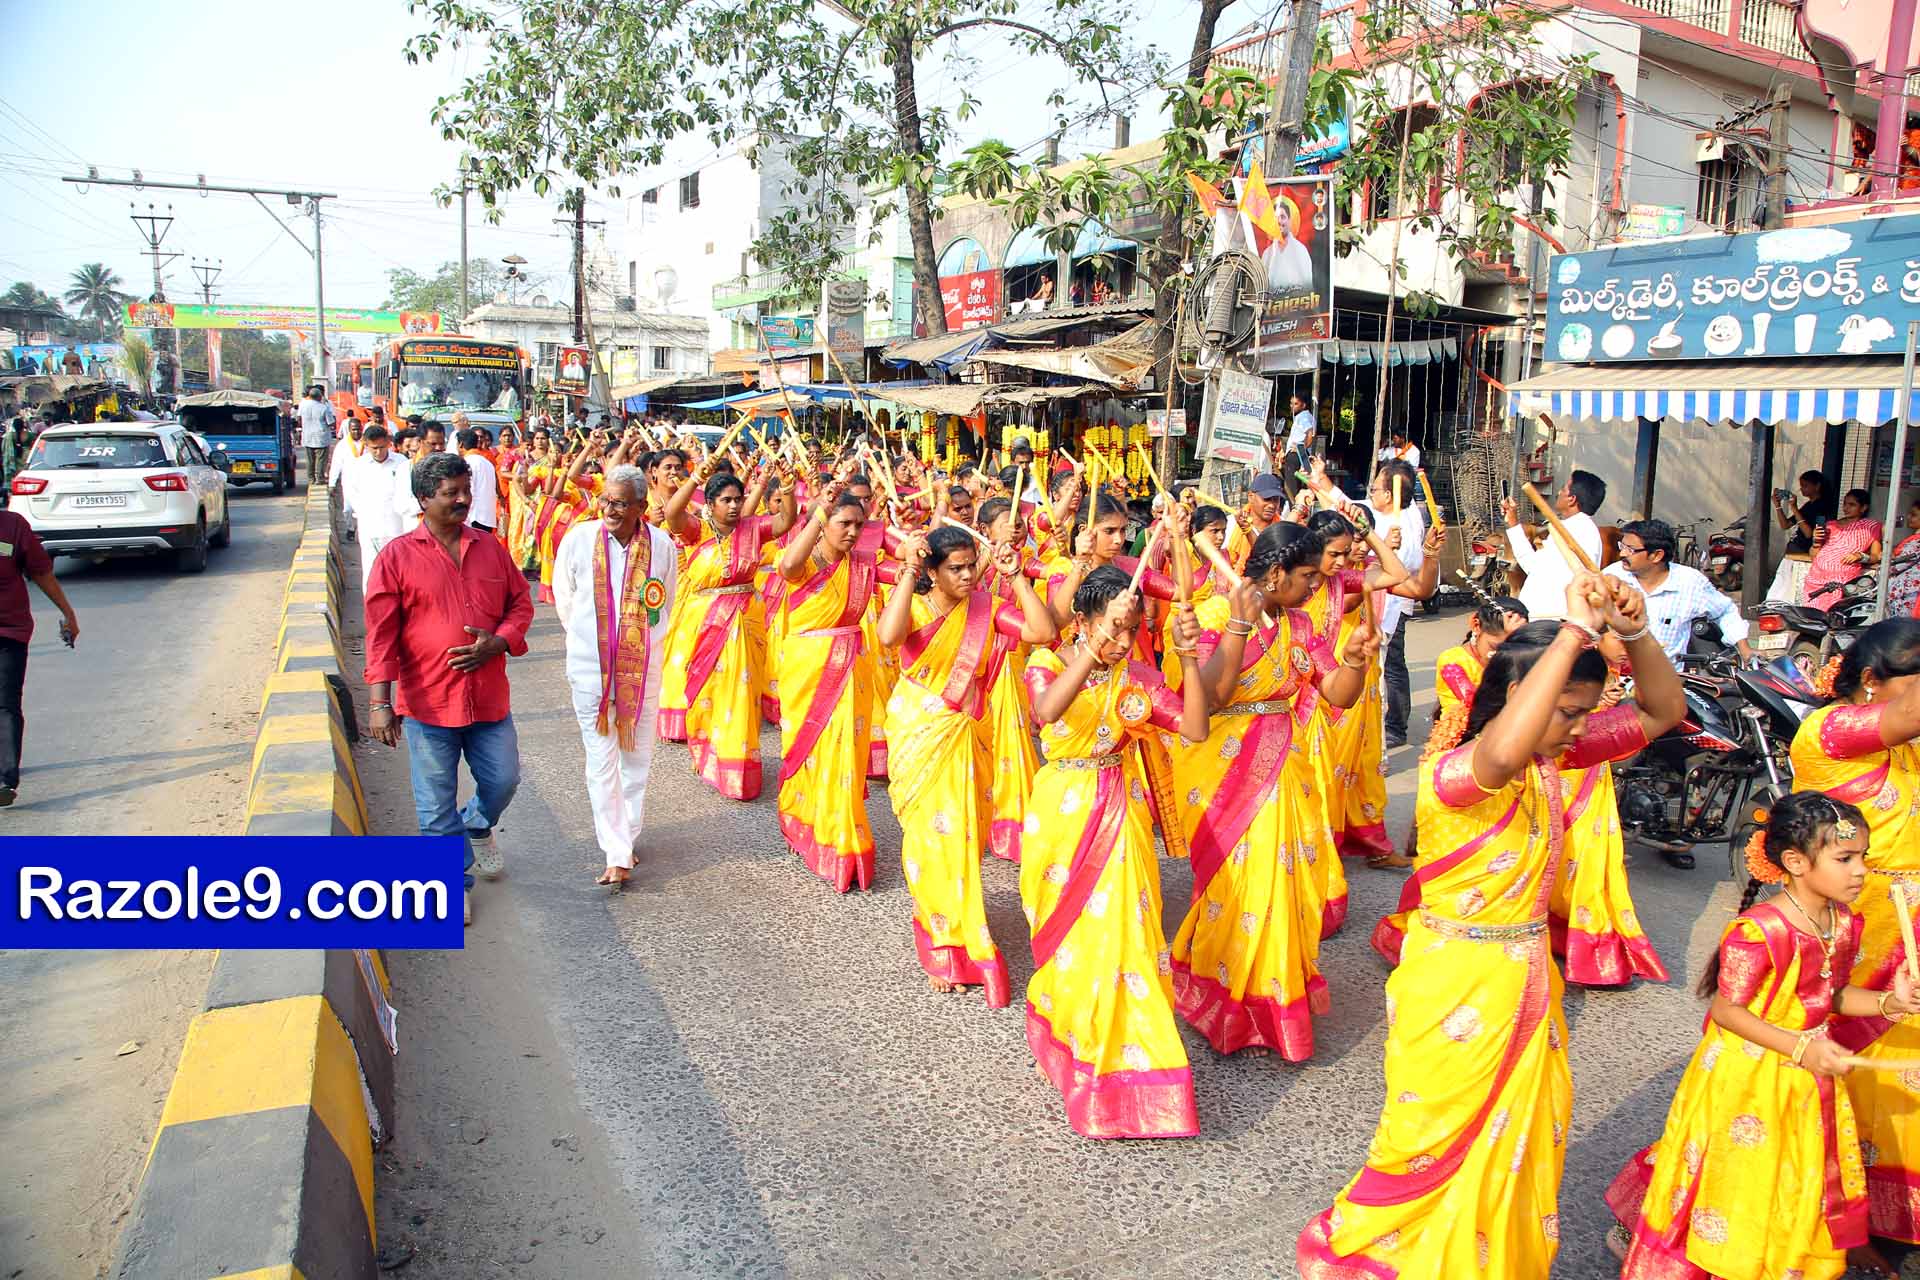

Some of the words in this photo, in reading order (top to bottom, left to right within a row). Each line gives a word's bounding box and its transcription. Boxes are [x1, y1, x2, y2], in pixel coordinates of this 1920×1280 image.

[1871, 274, 1890, 293] &
[1265, 291, 1321, 316] ajesh
[1259, 319, 1298, 336] ANESH
[78, 446, 117, 457] JSR
